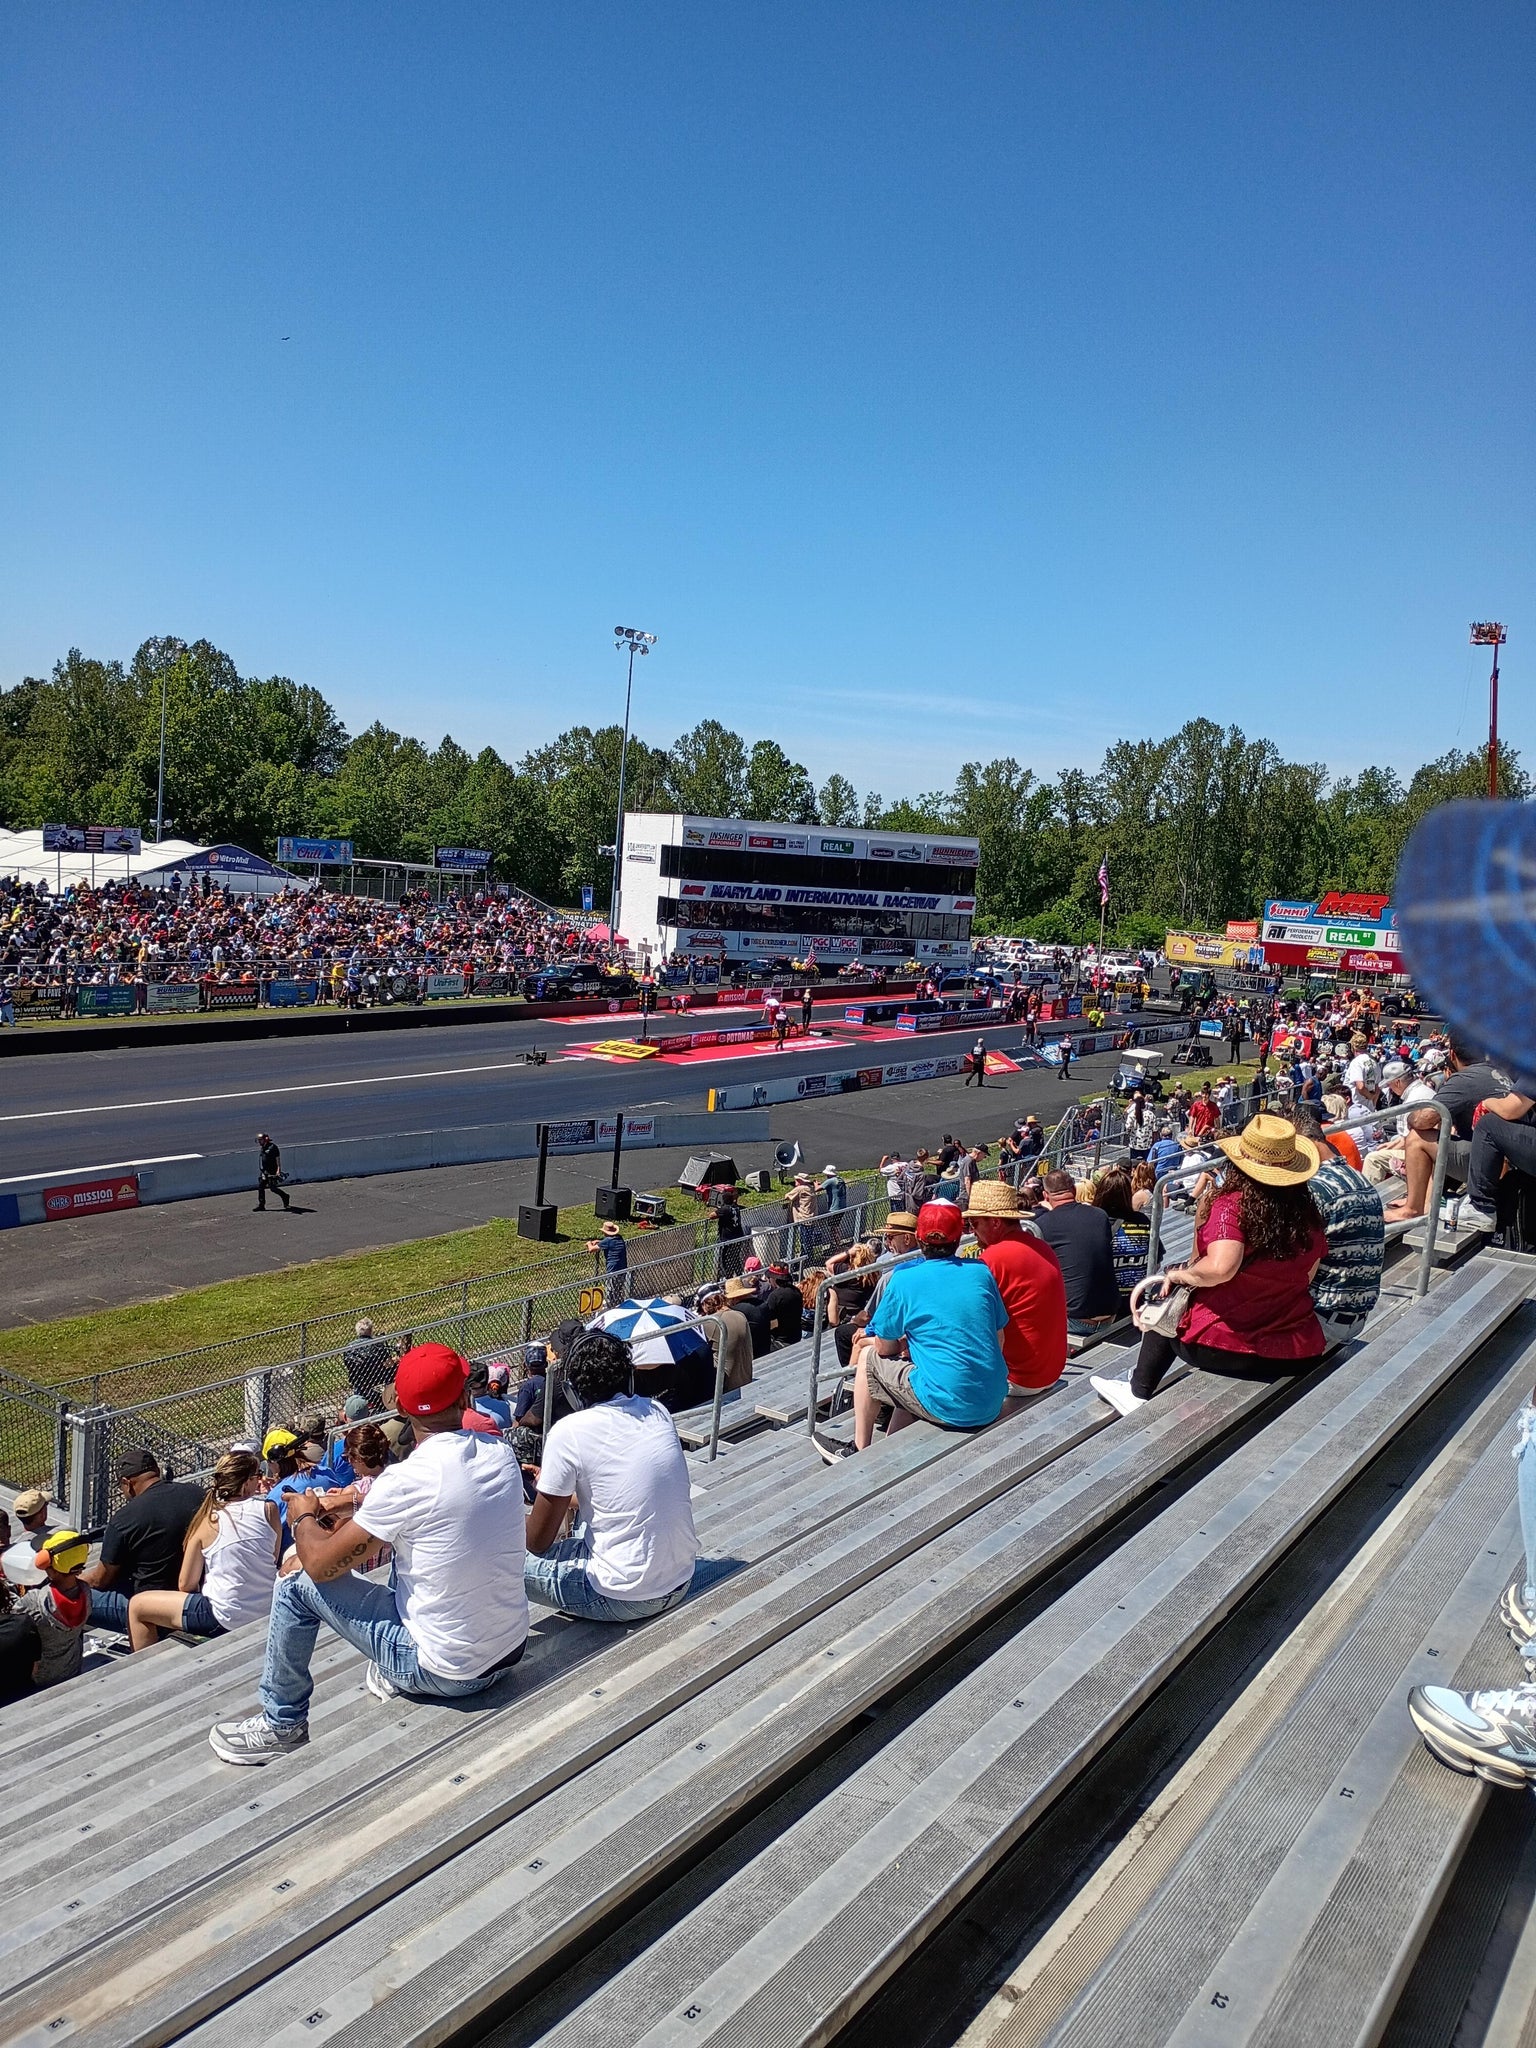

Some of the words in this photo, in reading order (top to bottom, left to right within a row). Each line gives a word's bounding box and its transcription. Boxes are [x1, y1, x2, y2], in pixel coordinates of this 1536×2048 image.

[710, 831, 744, 841] INSINGER
[297, 846, 322, 859] Chill
[822, 842, 845, 852] REAL
[710, 884, 783, 901] MARYLAND
[785, 889, 879, 907] INTERNATIONAL
[882, 894, 942, 910] RACEWAY
[1315, 892, 1390, 919] MIR
[1267, 925, 1287, 939] ATI
[1287, 928, 1320, 936] PERFORMANCE
[1329, 932, 1361, 943] REAL
[1356, 960, 1384, 969] MARY'S
[433, 978, 459, 987] UniFirst
[579, 1287, 604, 1314] DD
[1426, 1647, 1440, 1657] 10
[695, 1742, 707, 1751] 10
[454, 1775, 465, 1783] 10
[1339, 1787, 1355, 1799] 11
[528, 1859, 542, 1870] 11
[277, 1881, 291, 1890] 11
[67, 1900, 80, 1909] 11
[1210, 1991, 1229, 2009] 12
[306, 2010, 323, 2024] 12
[683, 2004, 701, 2019] 12
[48, 2016, 64, 2028] 12
